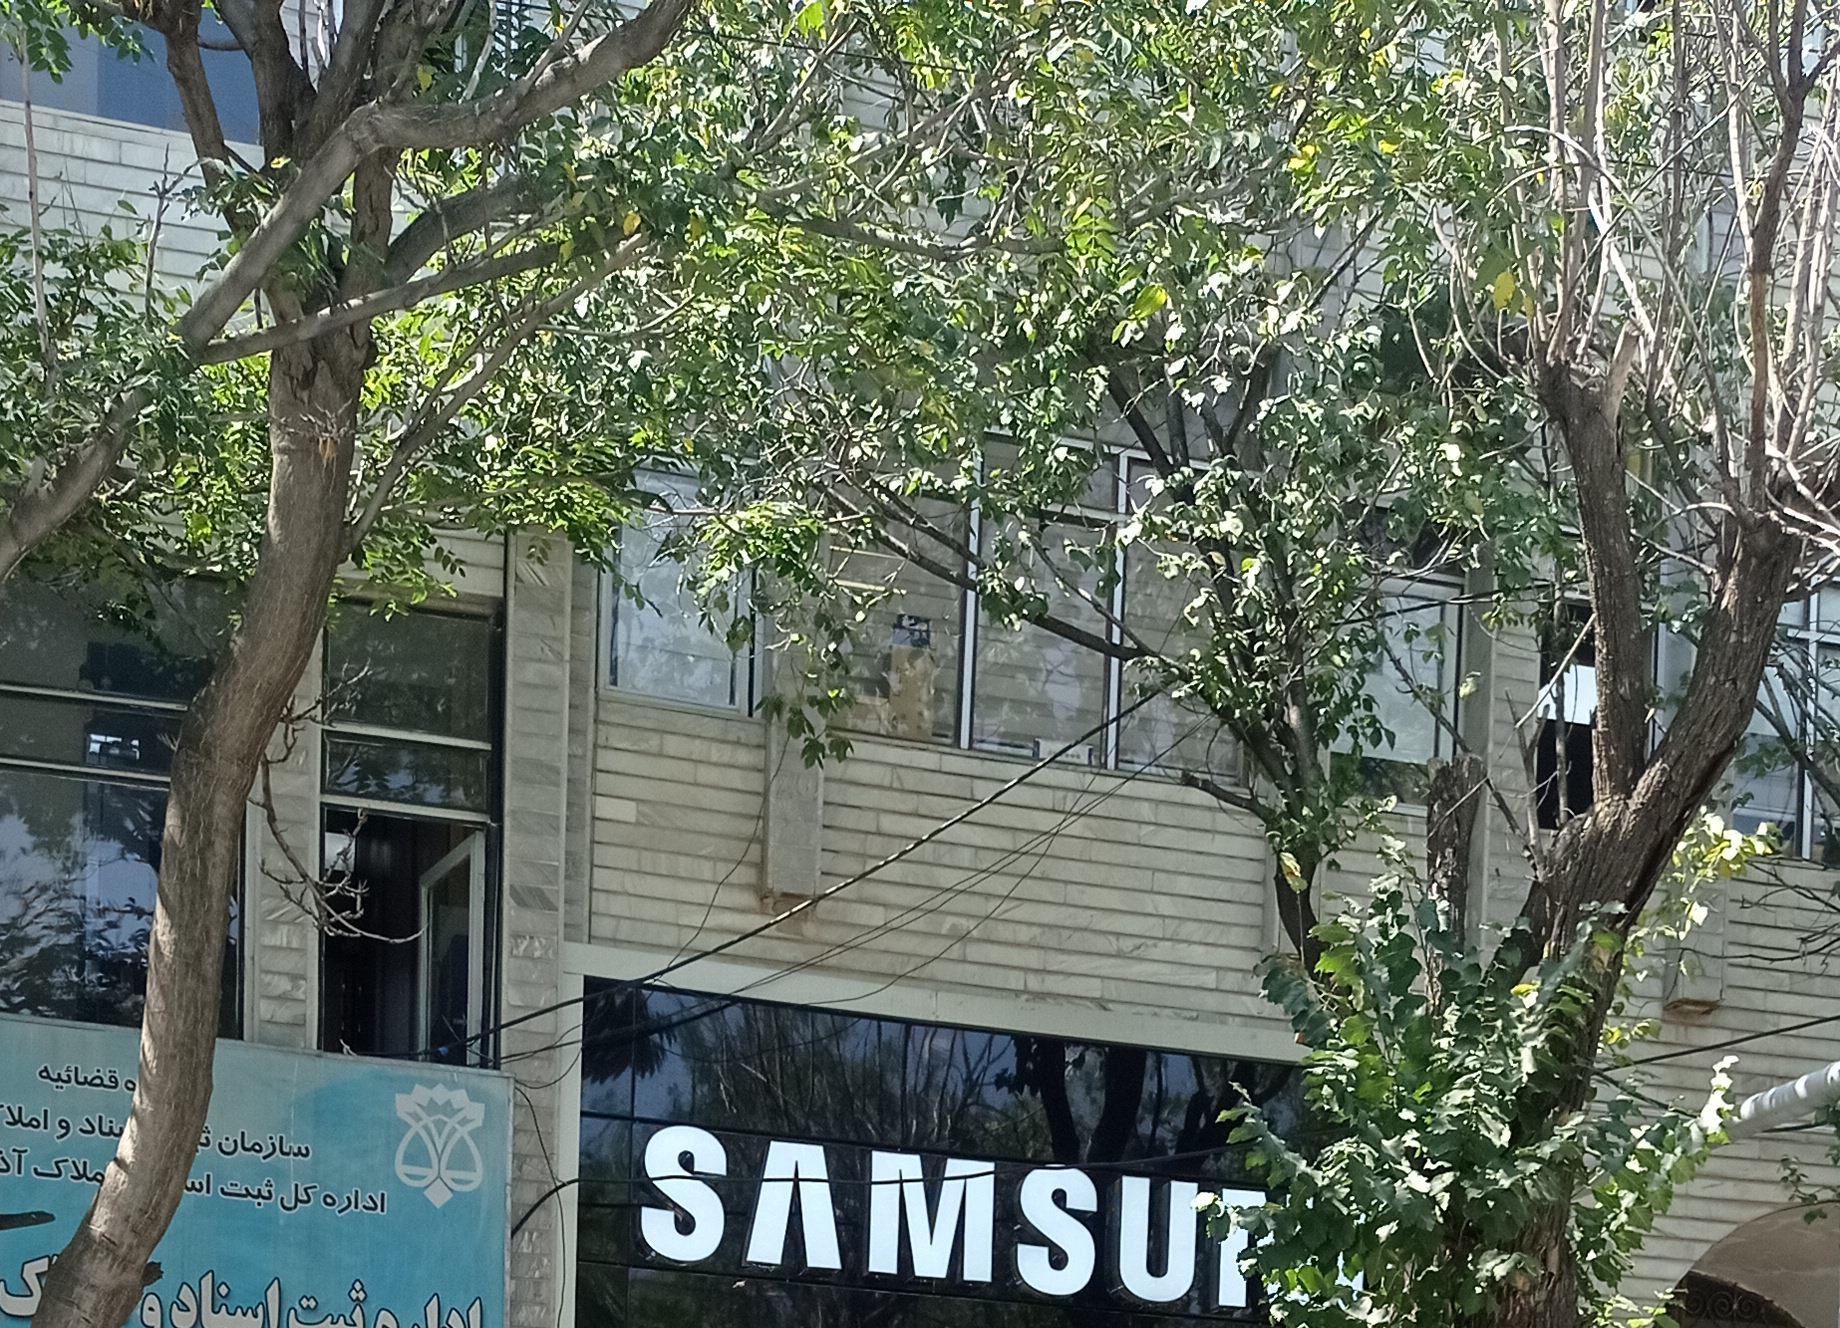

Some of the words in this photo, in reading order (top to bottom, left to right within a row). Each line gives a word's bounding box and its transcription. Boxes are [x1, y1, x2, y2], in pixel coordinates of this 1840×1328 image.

[37, 1064, 120, 1091] قضائیه
[0, 1103, 49, 1131] املا
[55, 1116, 72, 1141] و
[216, 1130, 311, 1161] سازمان
[33, 1157, 105, 1188] ملاک
[219, 1178, 275, 1208] ثبت
[279, 1182, 319, 1212] کل
[322, 1188, 387, 1215] اداره
[640, 1124, 1364, 1312] SAMSU
